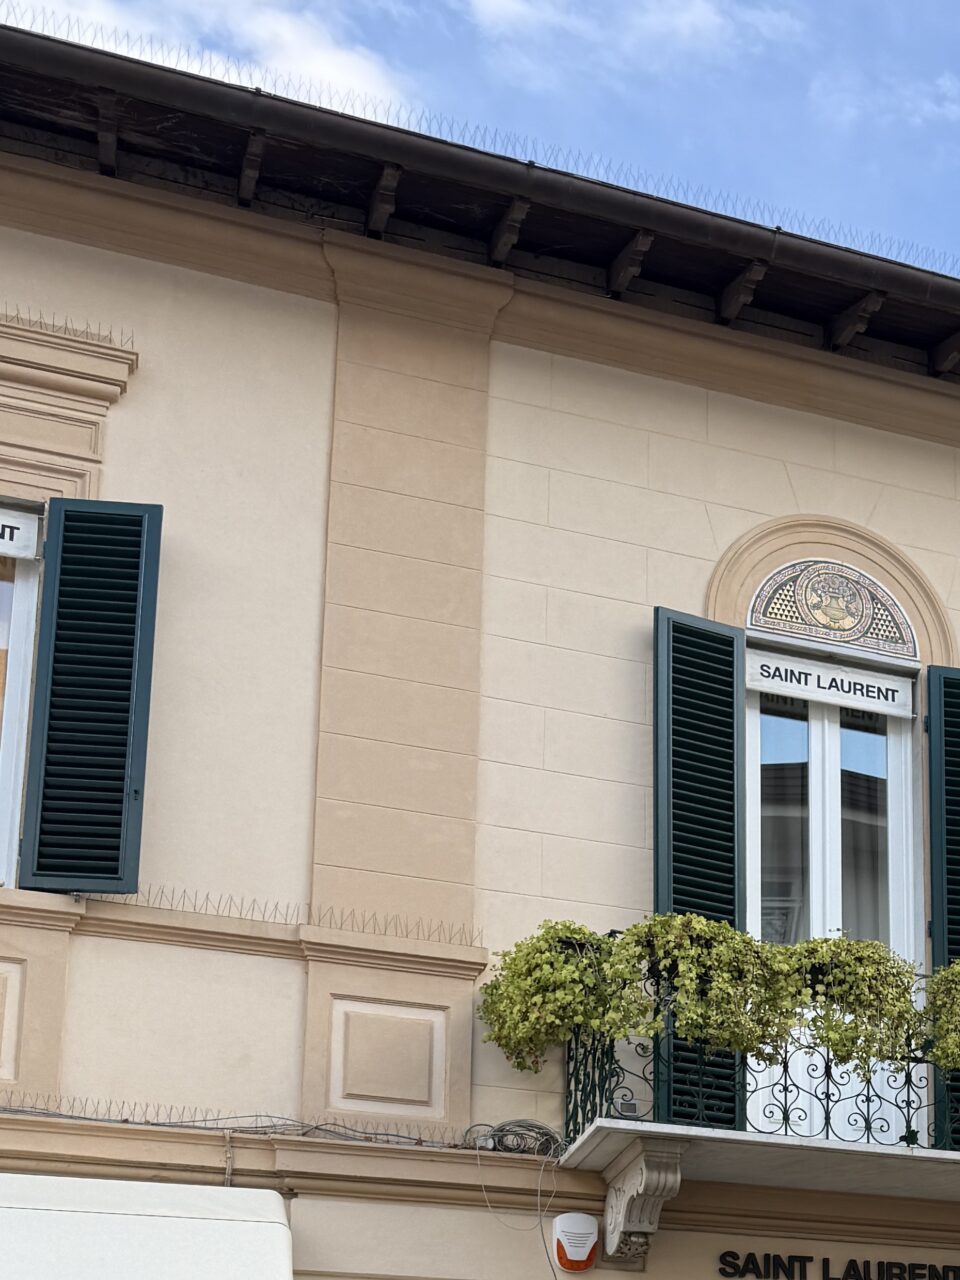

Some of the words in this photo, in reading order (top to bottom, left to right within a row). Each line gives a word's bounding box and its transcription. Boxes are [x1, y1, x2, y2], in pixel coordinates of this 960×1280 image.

[759, 663, 812, 686] SAINT
[816, 674, 899, 702] LAURENT
[718, 1250, 814, 1280] SAINT
